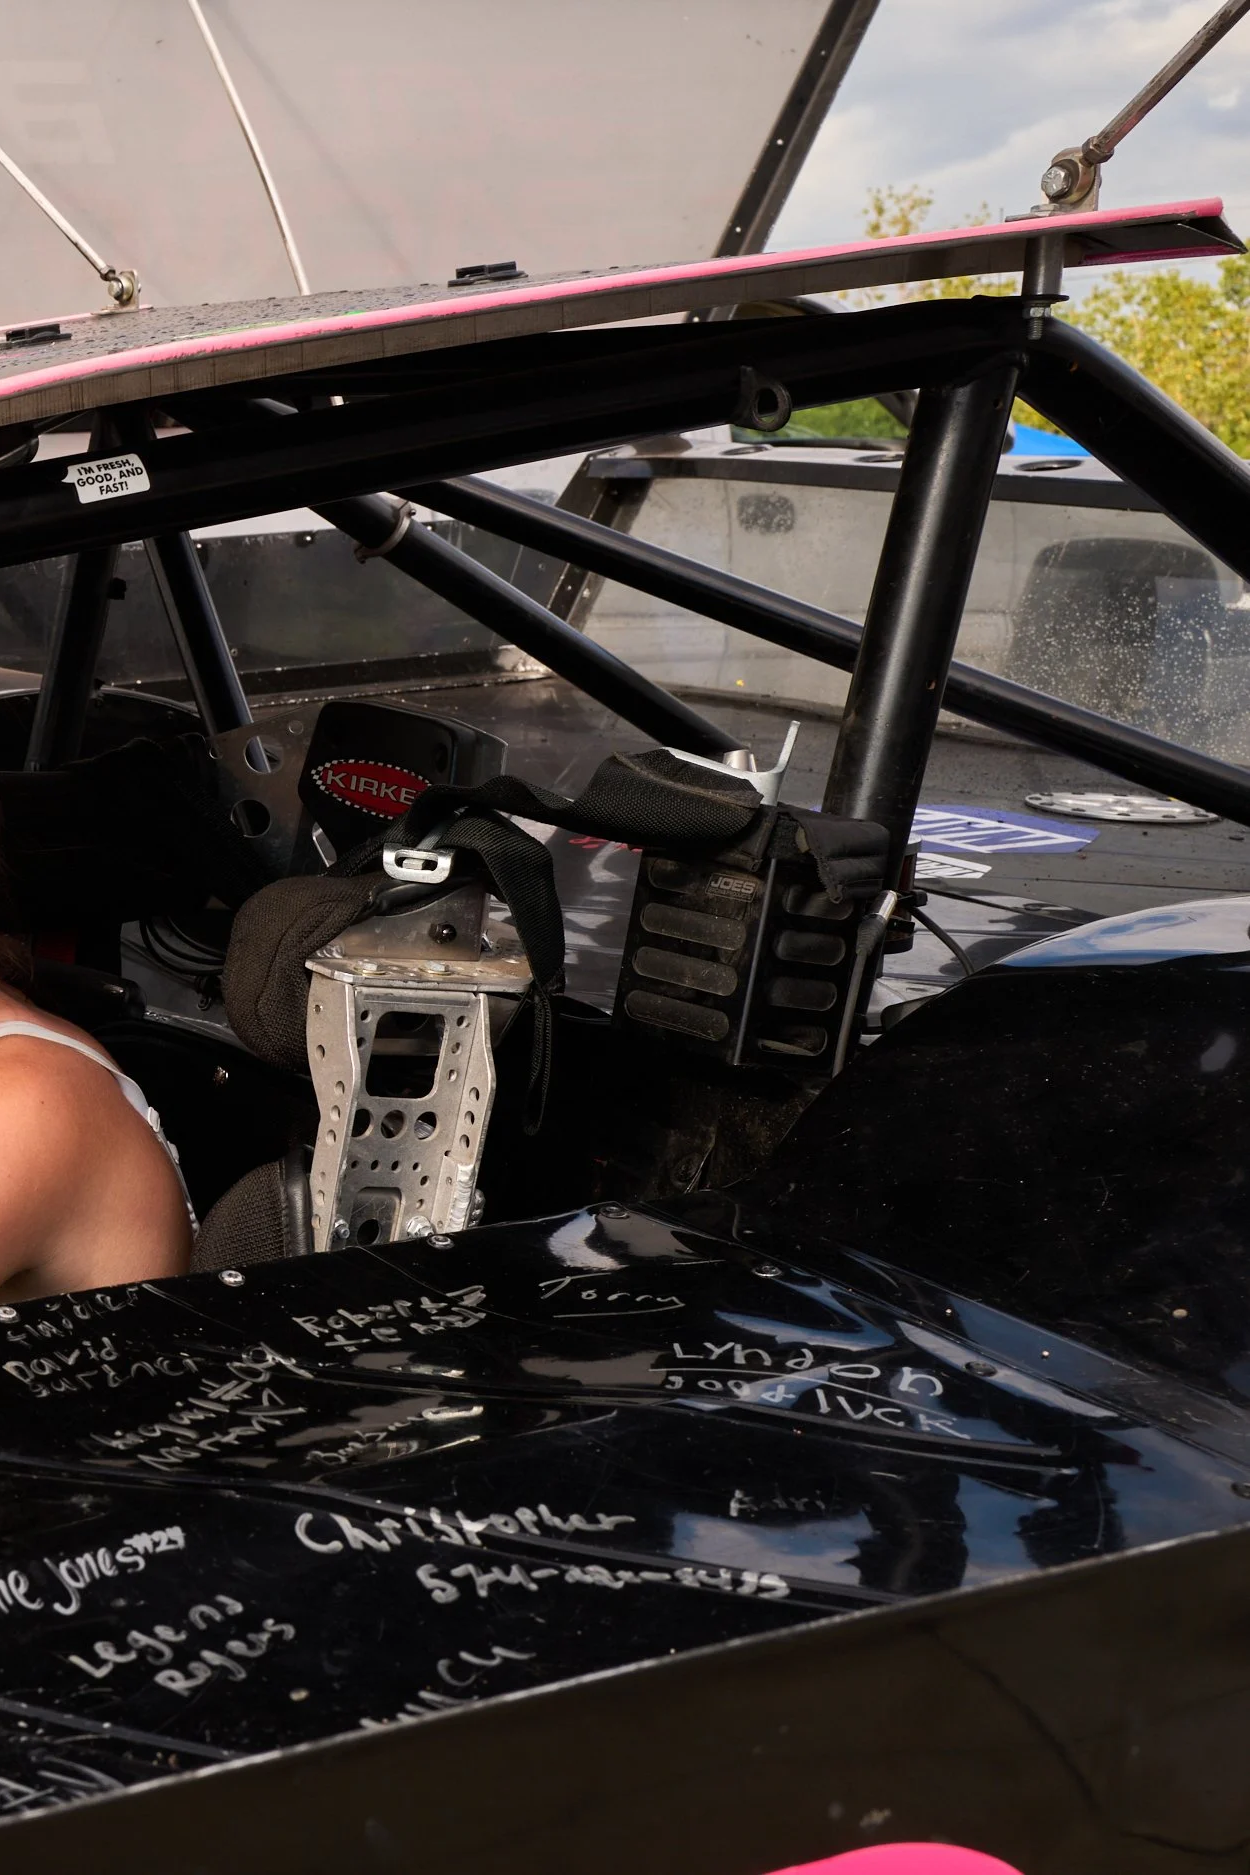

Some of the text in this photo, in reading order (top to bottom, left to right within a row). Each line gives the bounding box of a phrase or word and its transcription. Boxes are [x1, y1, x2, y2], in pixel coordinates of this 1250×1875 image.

[76, 466, 144, 487] GOOD, AND
[77, 458, 134, 476] I'M FRESH,
[99, 481, 129, 495] FAST!
[326, 769, 417, 805] KIRKE
[710, 876, 756, 894] JOES
[2, 1337, 119, 1385] David
